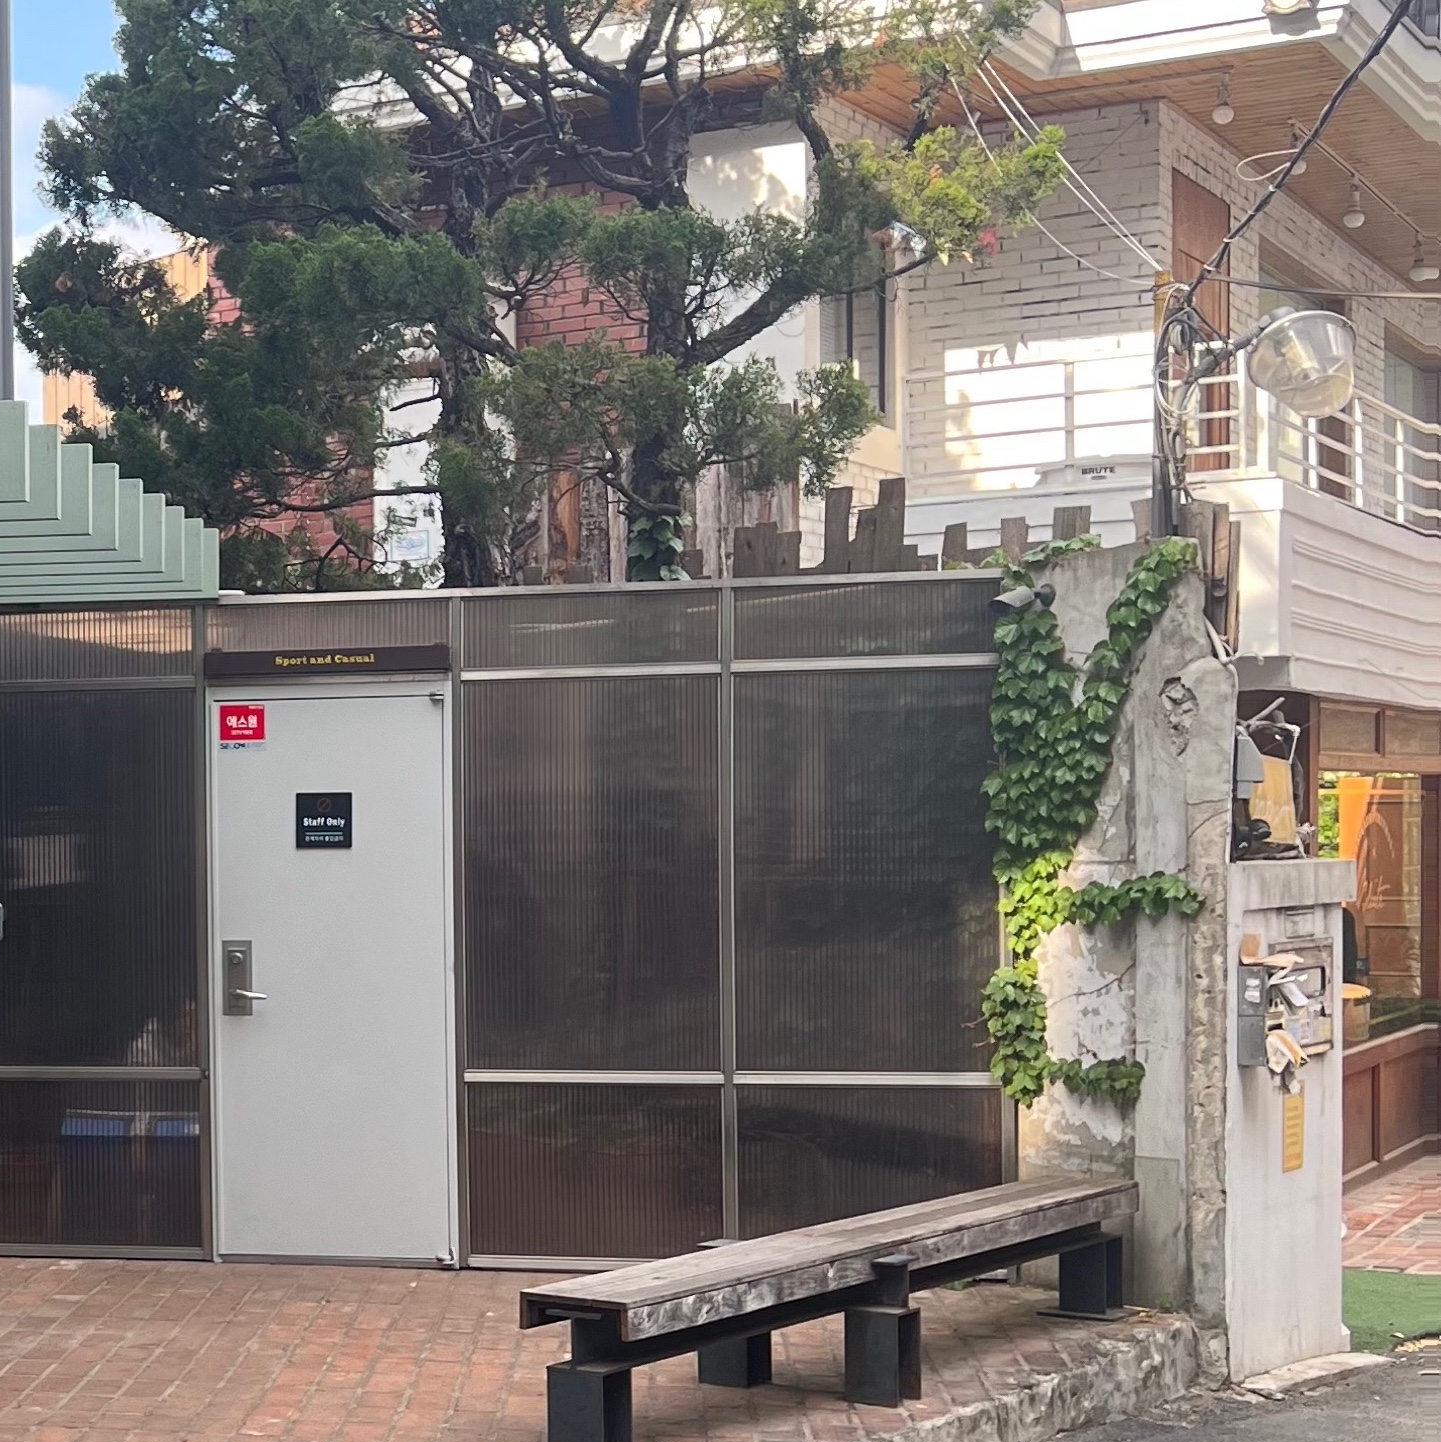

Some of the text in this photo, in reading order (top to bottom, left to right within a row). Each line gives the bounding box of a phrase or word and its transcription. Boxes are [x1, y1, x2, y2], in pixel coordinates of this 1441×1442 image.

[275, 653, 375, 667] Sport and Casual
[303, 816, 346, 828] Staff Only
